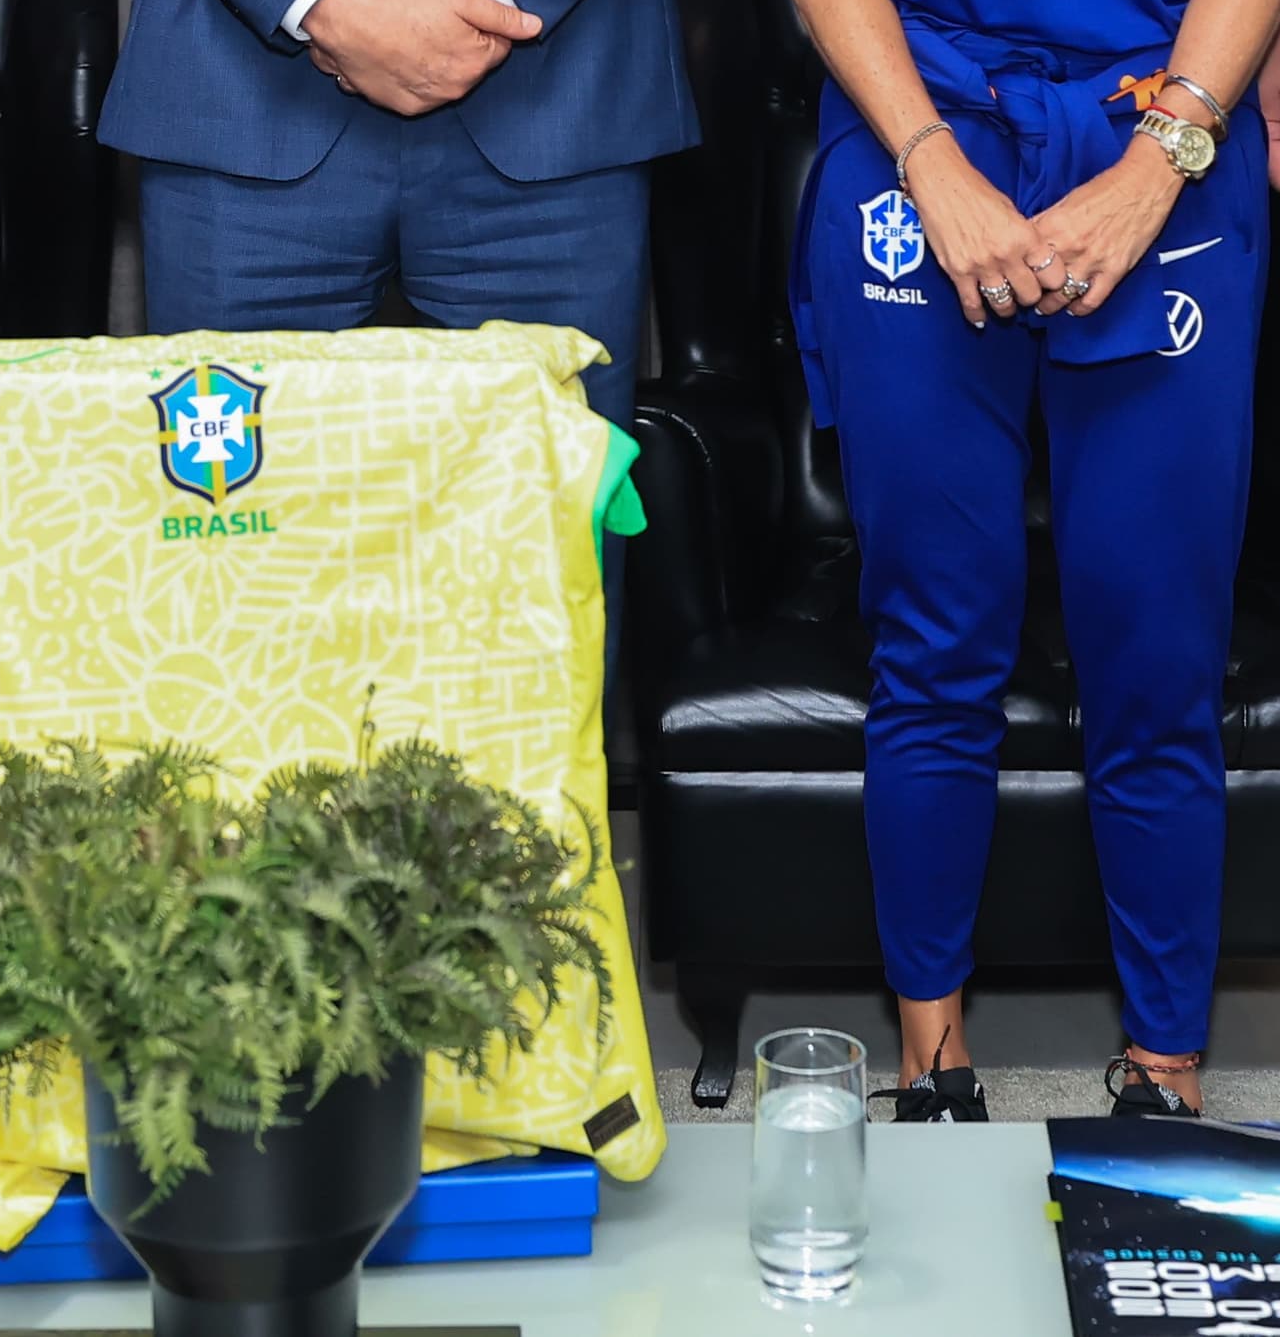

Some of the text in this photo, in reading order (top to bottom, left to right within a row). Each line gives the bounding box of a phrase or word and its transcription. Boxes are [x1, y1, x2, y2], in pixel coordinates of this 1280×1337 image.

[882, 226, 906, 237] CBF
[863, 282, 928, 305] BRASIL
[190, 420, 231, 437] CBF
[162, 511, 277, 540] BRASIL
[1103, 1248, 1203, 1261] COSMOS
[1216, 1251, 1261, 1263] THE
[1107, 1279, 1213, 1299] DO
